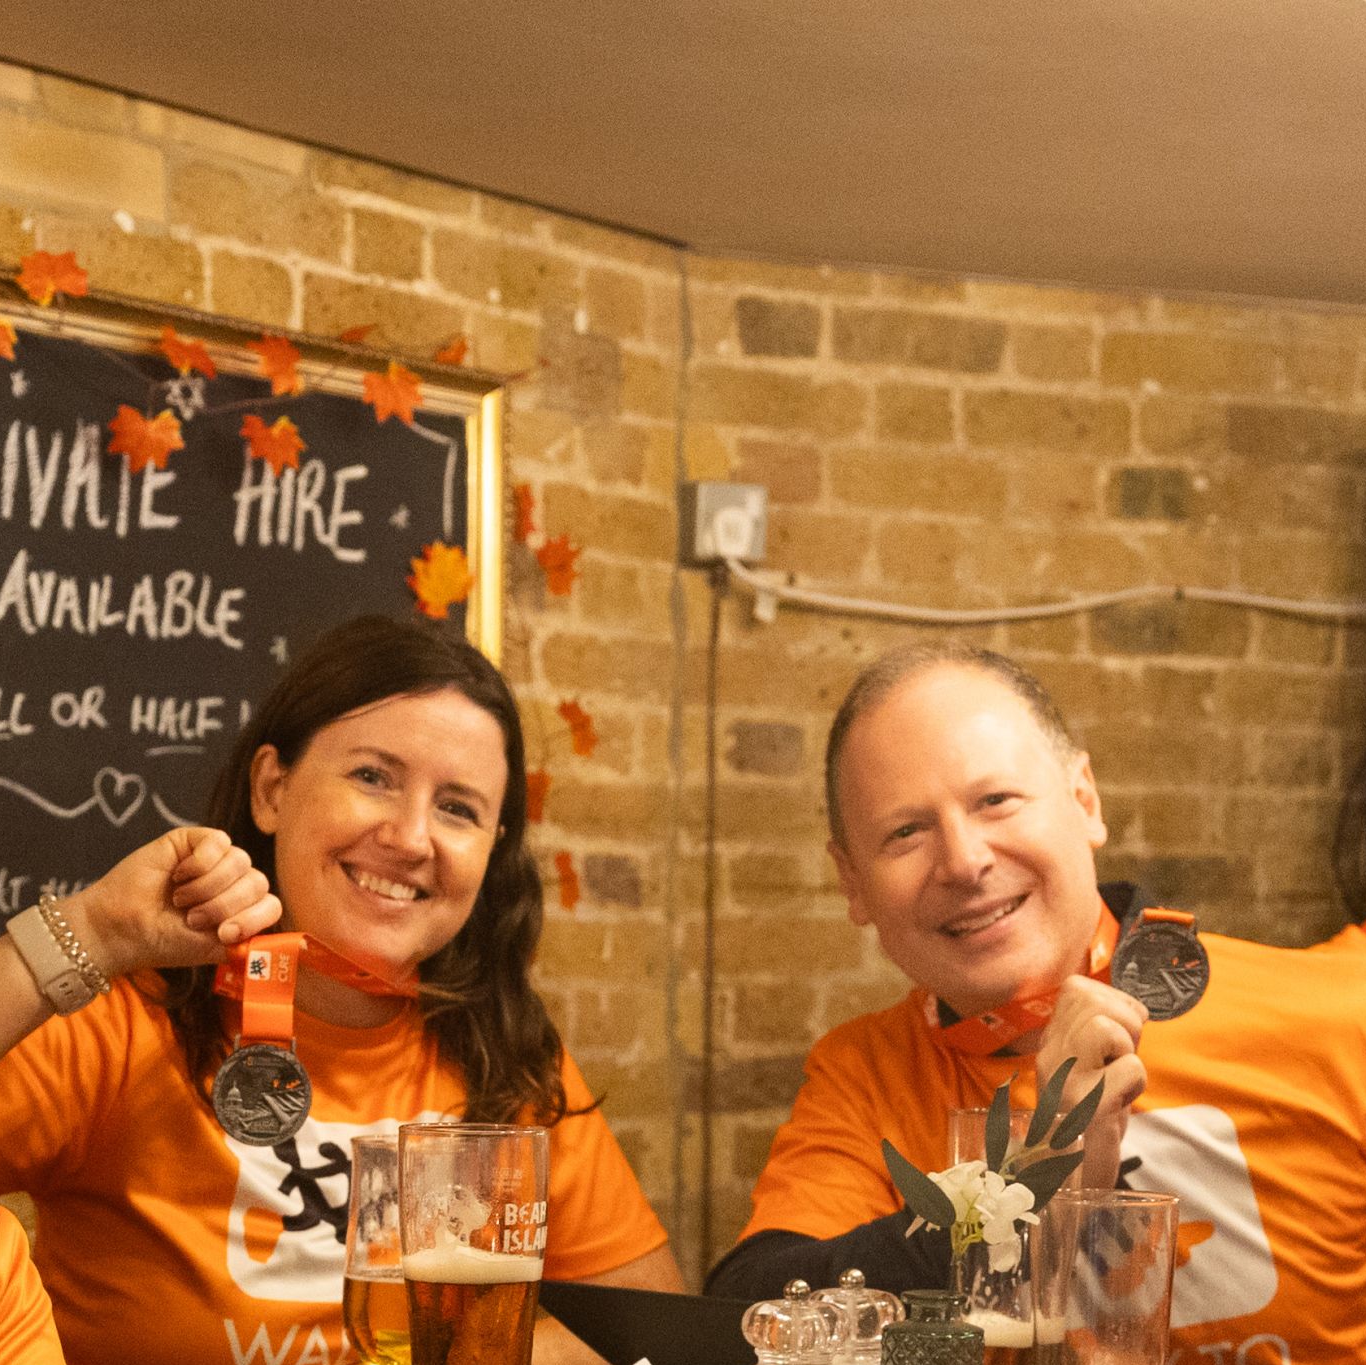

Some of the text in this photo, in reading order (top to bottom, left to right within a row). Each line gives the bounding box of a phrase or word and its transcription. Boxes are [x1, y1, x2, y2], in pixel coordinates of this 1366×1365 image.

[233, 438, 368, 563] HIRE
[51, 685, 109, 729] OR
[131, 694, 226, 741] HALF
